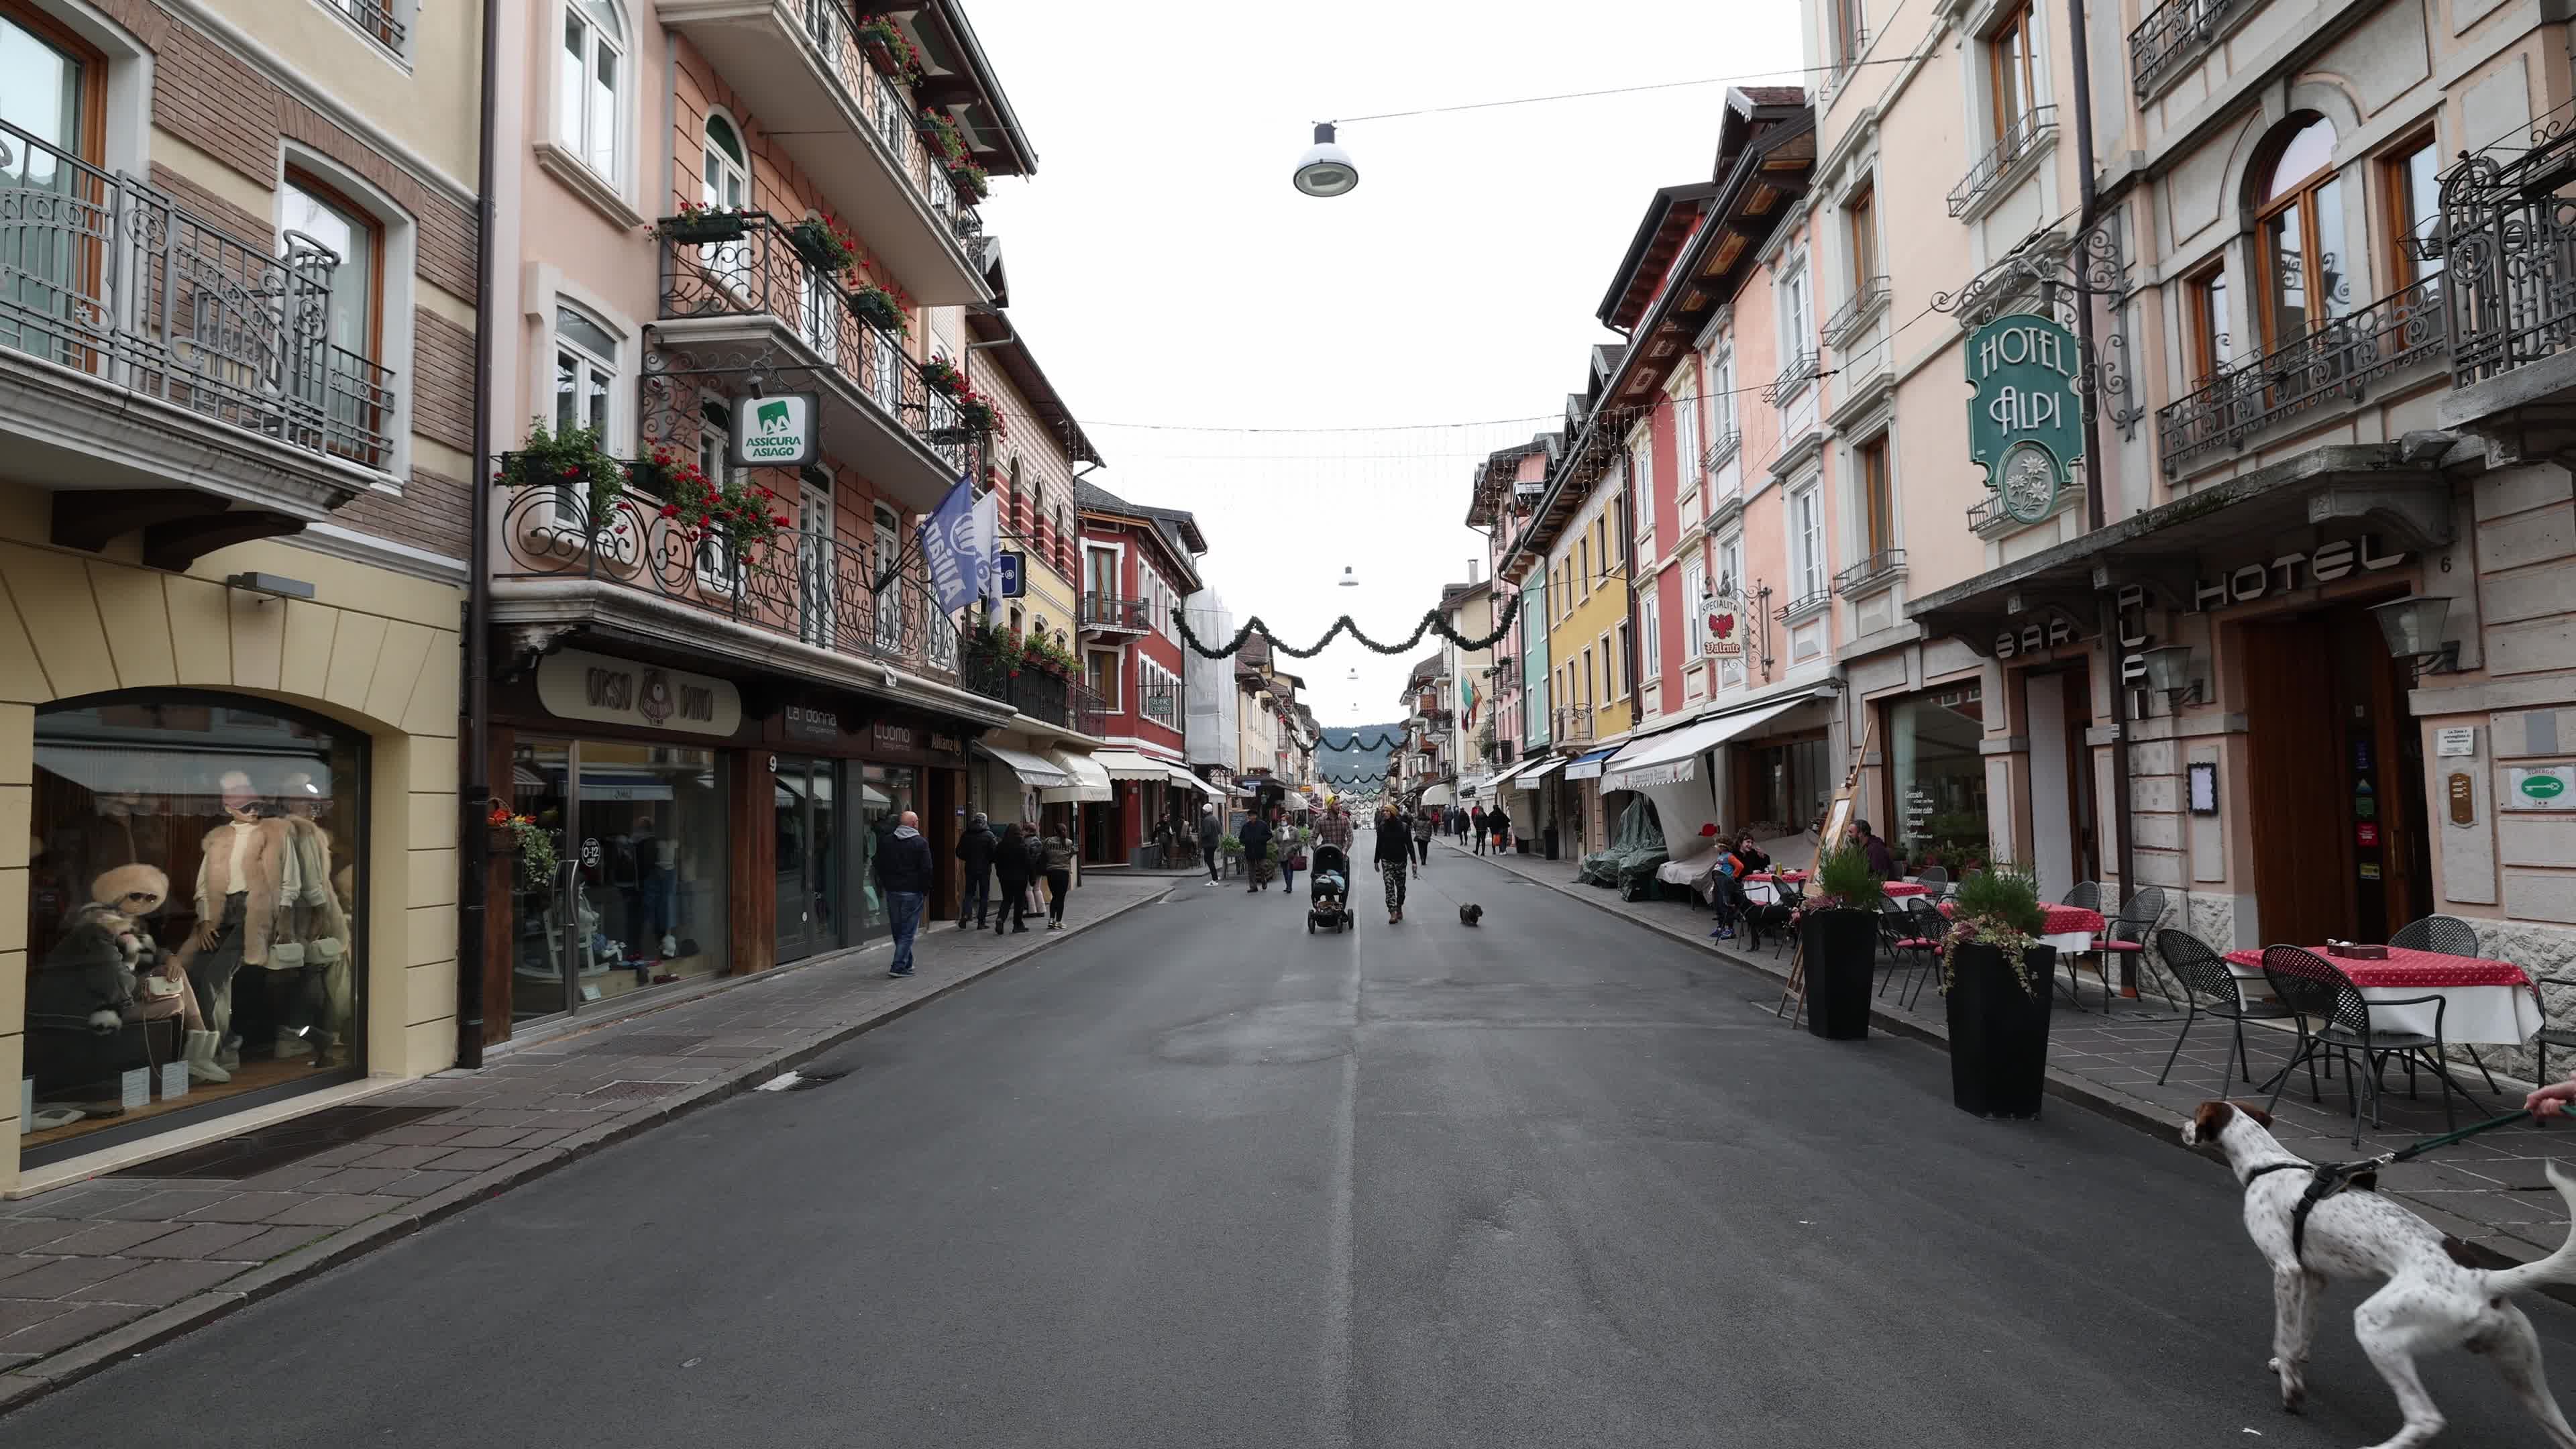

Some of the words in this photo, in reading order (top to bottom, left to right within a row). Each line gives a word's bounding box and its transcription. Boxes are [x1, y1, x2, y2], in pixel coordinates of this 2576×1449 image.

[1980, 327, 2069, 379] HOTEL
[1989, 386, 2061, 439] ALPI
[746, 436, 801, 447] ASSICURA
[753, 447, 794, 457] ASIAGO
[2196, 535, 2407, 611] HOTEL
[2440, 557, 2452, 573] 6
[1996, 616, 2072, 659] BAR
[1705, 641, 1741, 654] Valente
[586, 667, 633, 711] ORSO
[930, 733, 953, 752] Allianz
[769, 755, 777, 772] 9
[584, 847, 599, 858] 0-12
